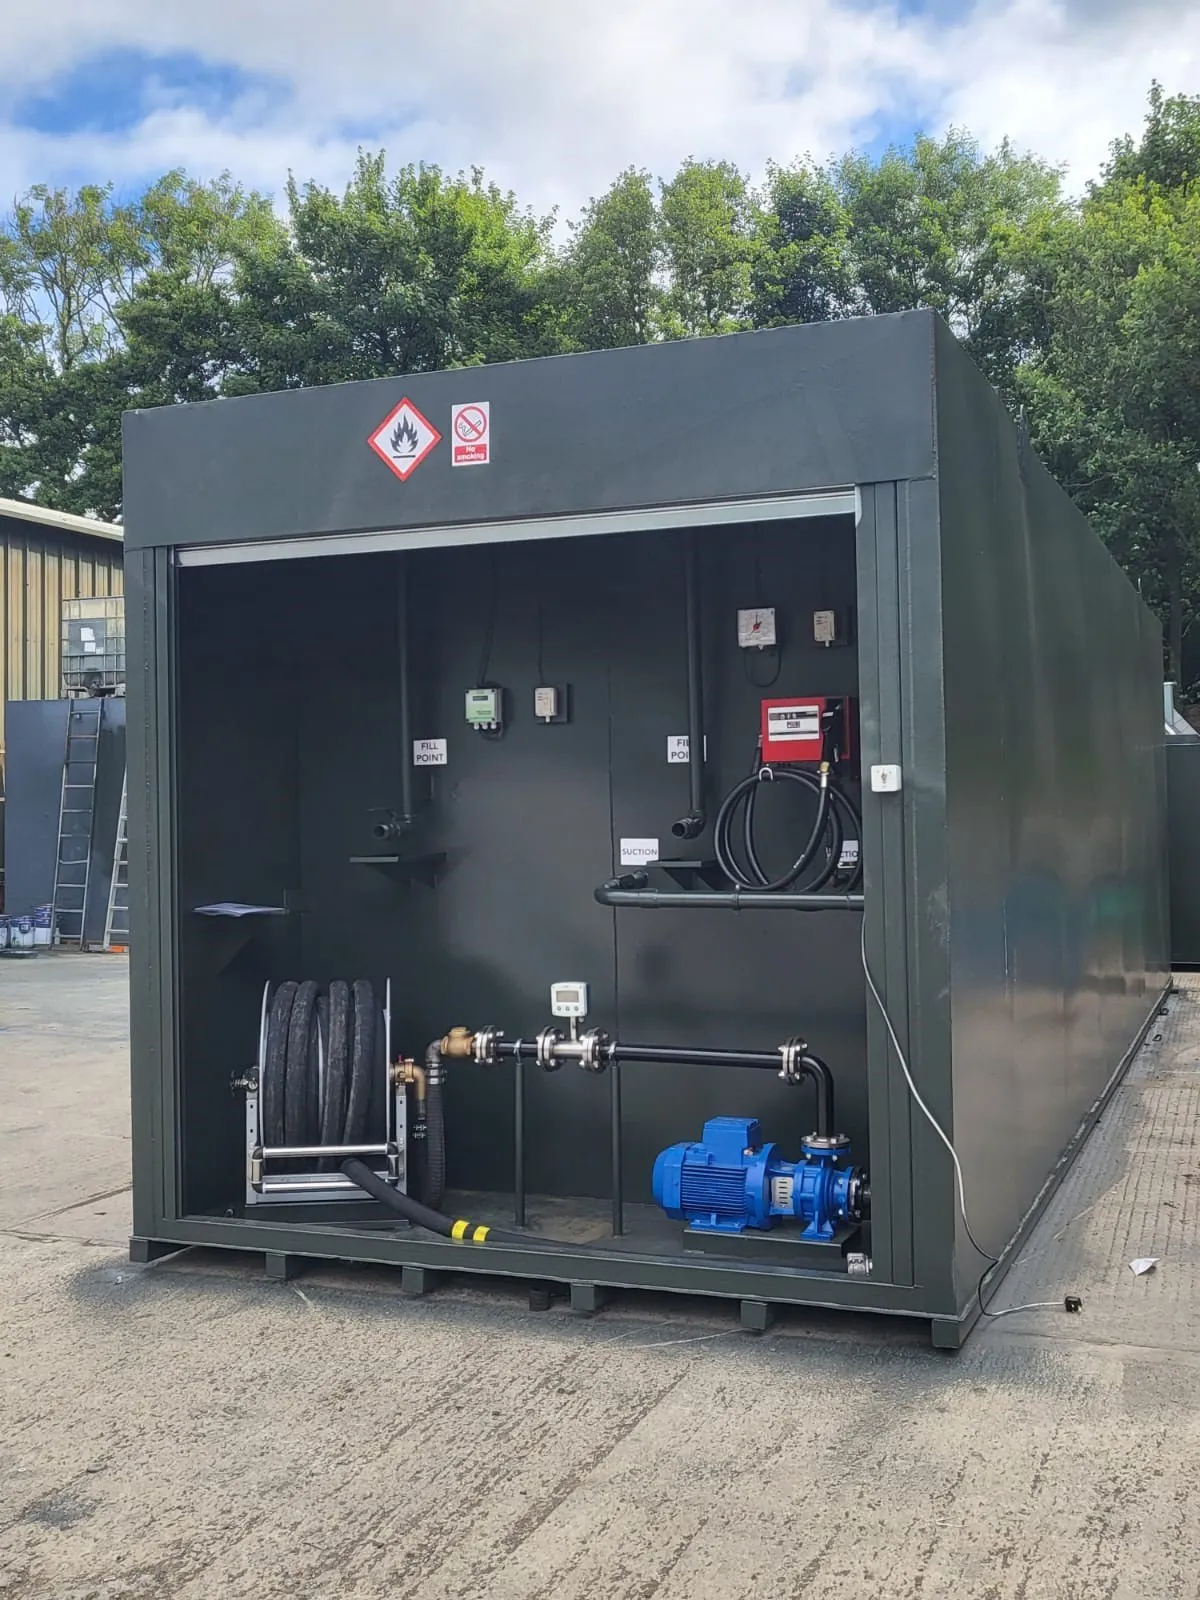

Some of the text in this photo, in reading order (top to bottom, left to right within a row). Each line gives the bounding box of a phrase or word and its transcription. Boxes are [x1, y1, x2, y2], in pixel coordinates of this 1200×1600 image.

[421, 742, 439, 750] FILL
[416, 753, 444, 763] POINT
[671, 750, 689, 760] POI
[622, 848, 657, 856] SUCTION
